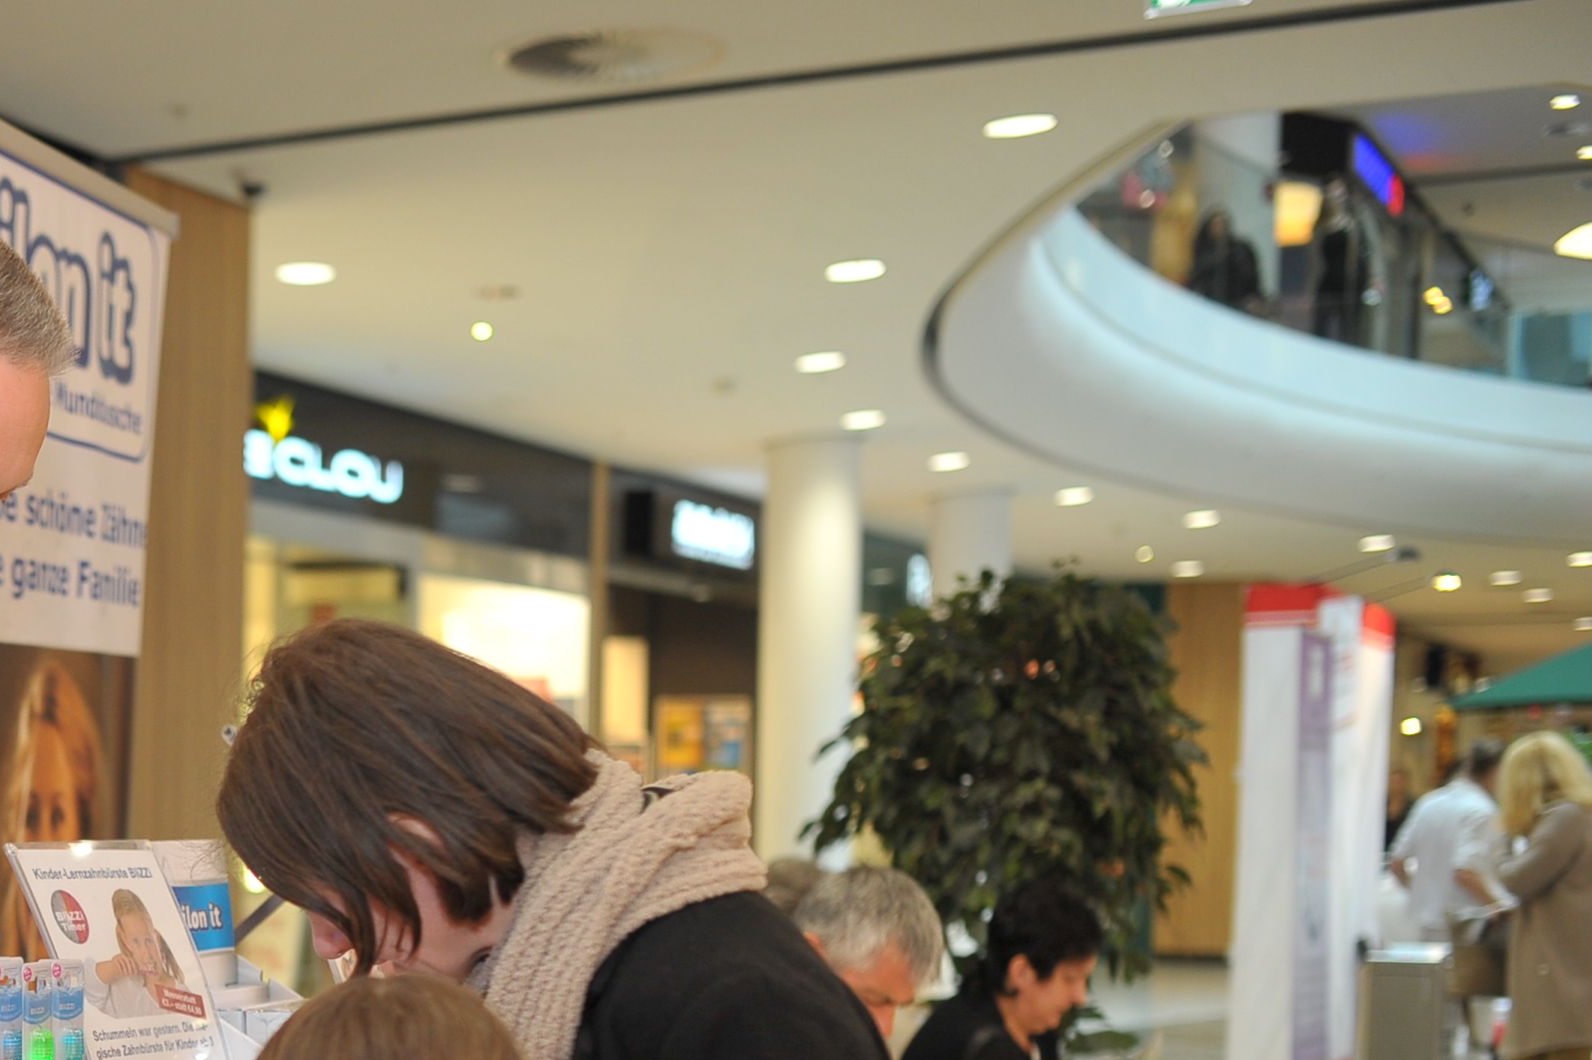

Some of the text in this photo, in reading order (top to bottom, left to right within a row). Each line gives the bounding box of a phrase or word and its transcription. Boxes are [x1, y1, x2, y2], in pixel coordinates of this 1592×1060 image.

[98, 229, 136, 385] it
[180, 901, 224, 932] ilon it
[92, 1027, 138, 1042] Schummeln
[138, 1028, 151, 1037] war
[122, 1042, 164, 1057] Zahnbürste
[164, 1040, 175, 1052] für
[176, 1037, 199, 1050] Kinder
